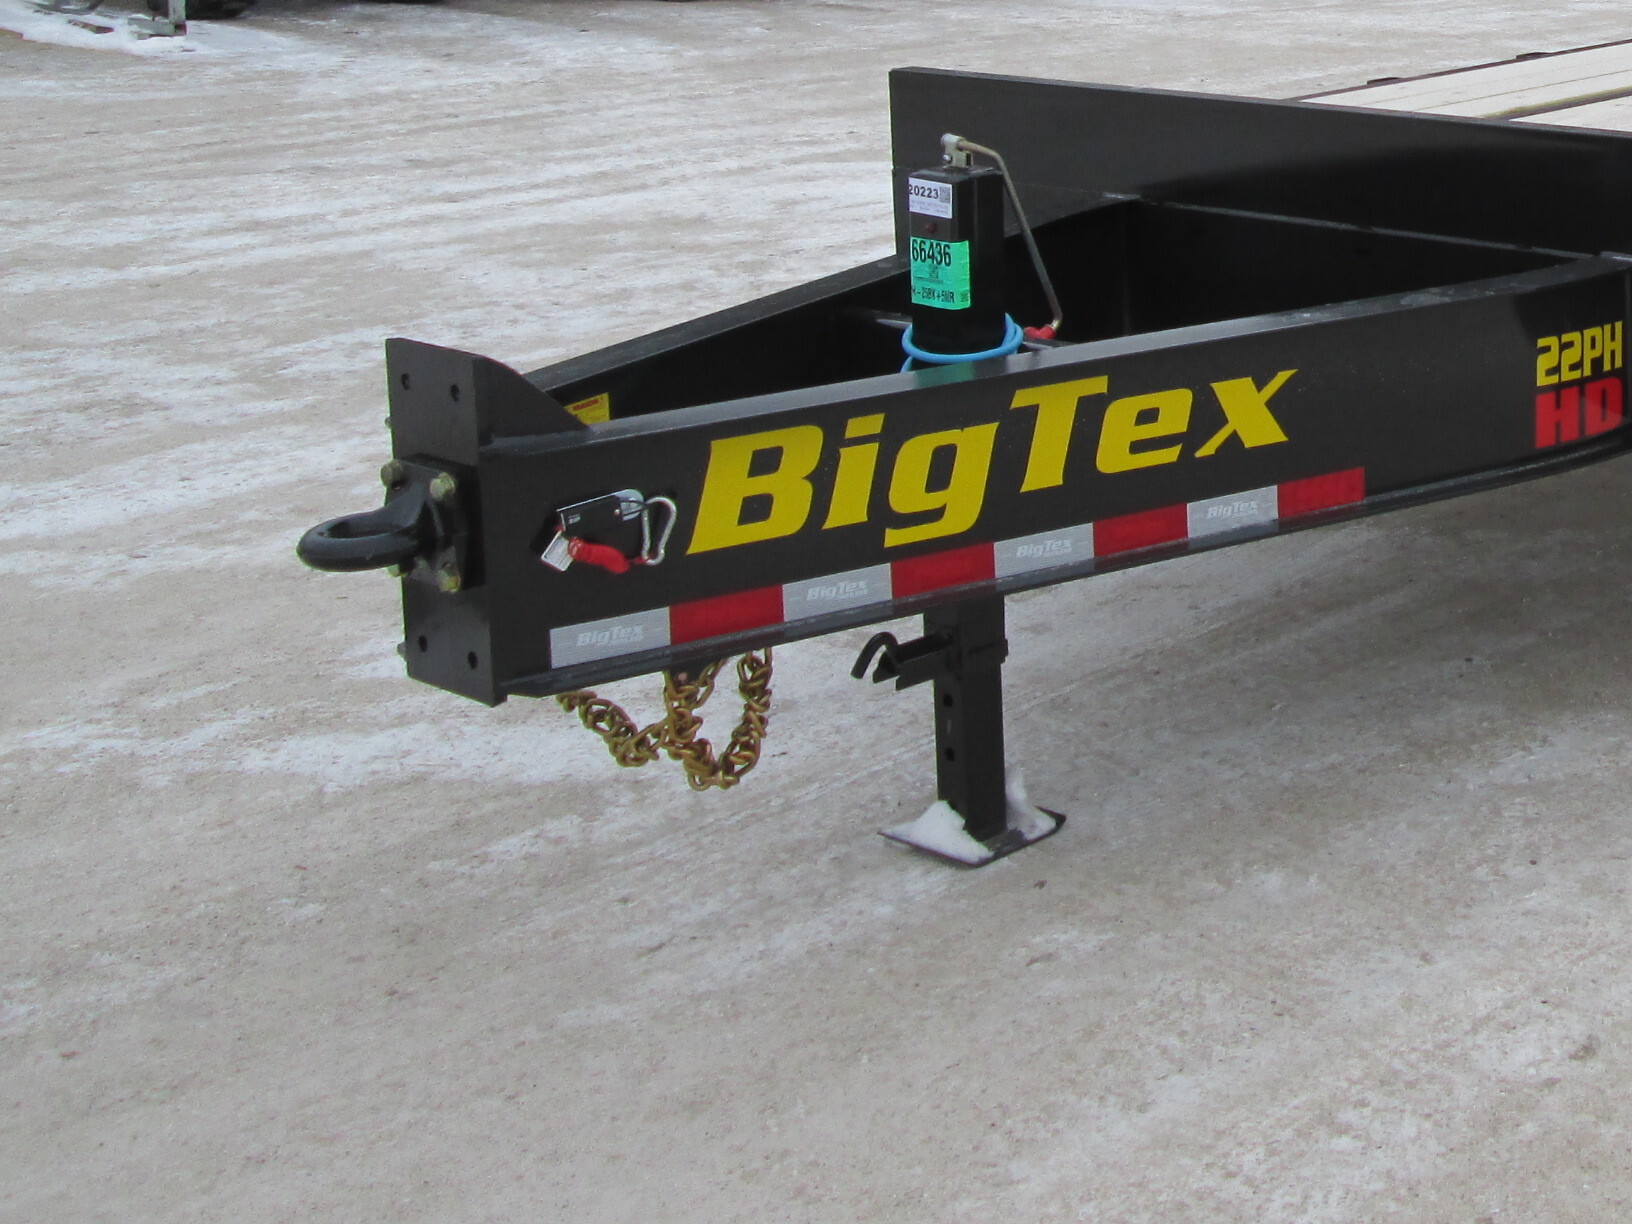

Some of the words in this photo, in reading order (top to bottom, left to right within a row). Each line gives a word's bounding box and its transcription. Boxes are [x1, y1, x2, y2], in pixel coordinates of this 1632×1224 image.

[911, 238, 952, 267] 66436
[1536, 320, 1623, 387] 22PH
[1535, 376, 1623, 449] HD
[686, 368, 1298, 555] BigTex
[1206, 500, 1258, 519] BigTex
[1016, 538, 1072, 558] BigTex
[806, 580, 868, 601] BigTex
[576, 625, 643, 647] BigTex
